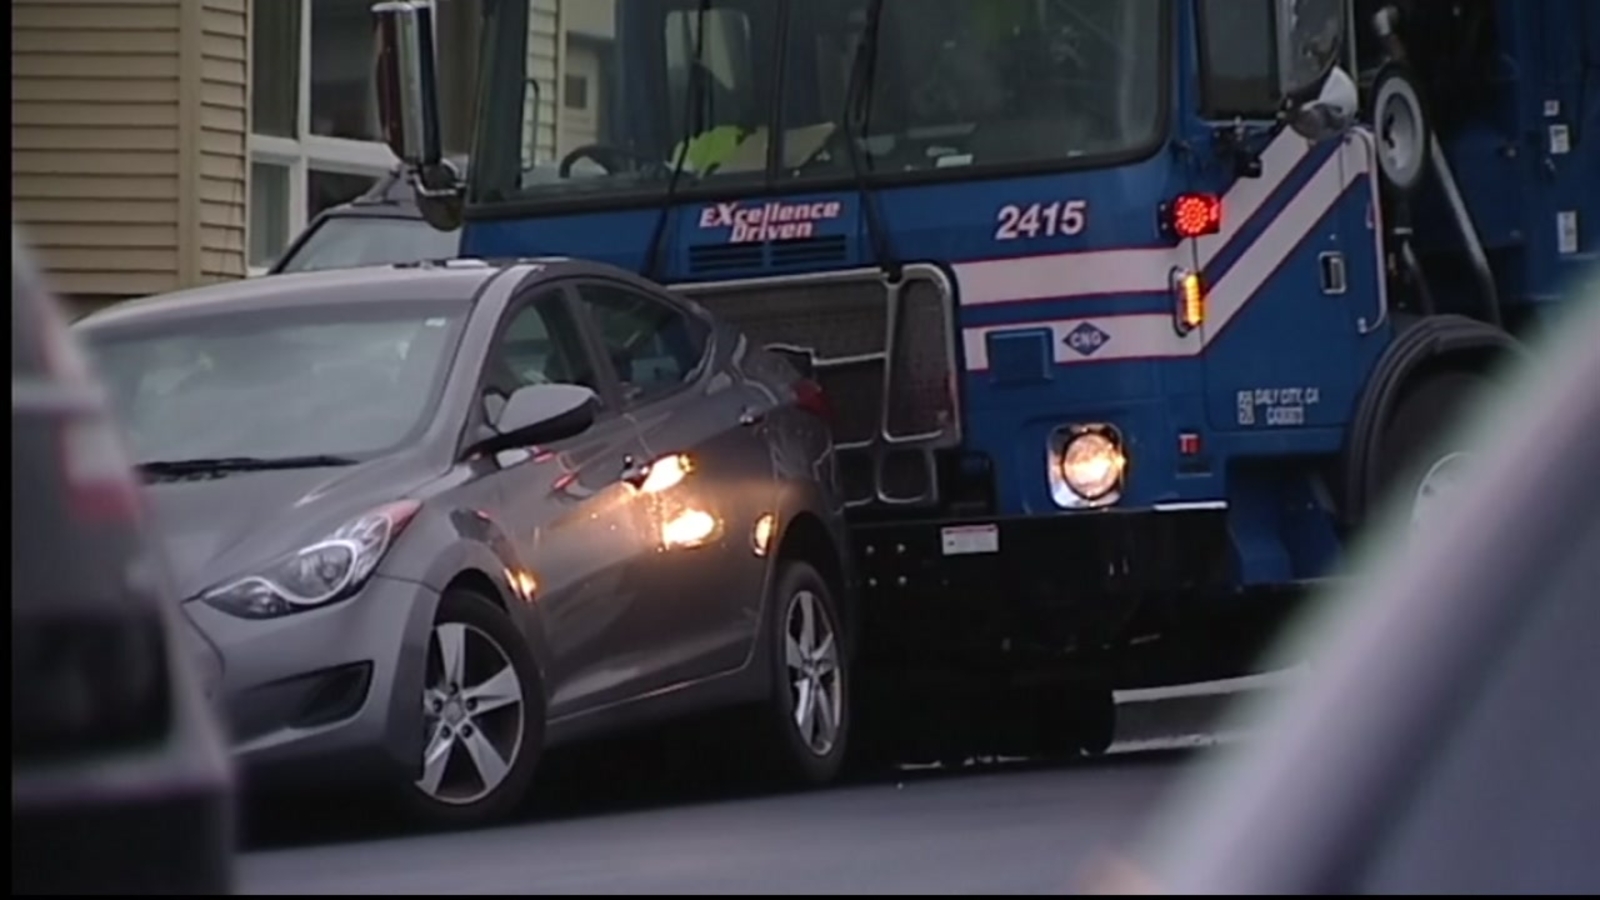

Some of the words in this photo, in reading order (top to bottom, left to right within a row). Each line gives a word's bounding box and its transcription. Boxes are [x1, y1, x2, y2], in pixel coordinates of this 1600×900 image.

[729, 219, 813, 243] Driven
[995, 200, 1086, 240] 2415
[1069, 330, 1102, 348] CNG
